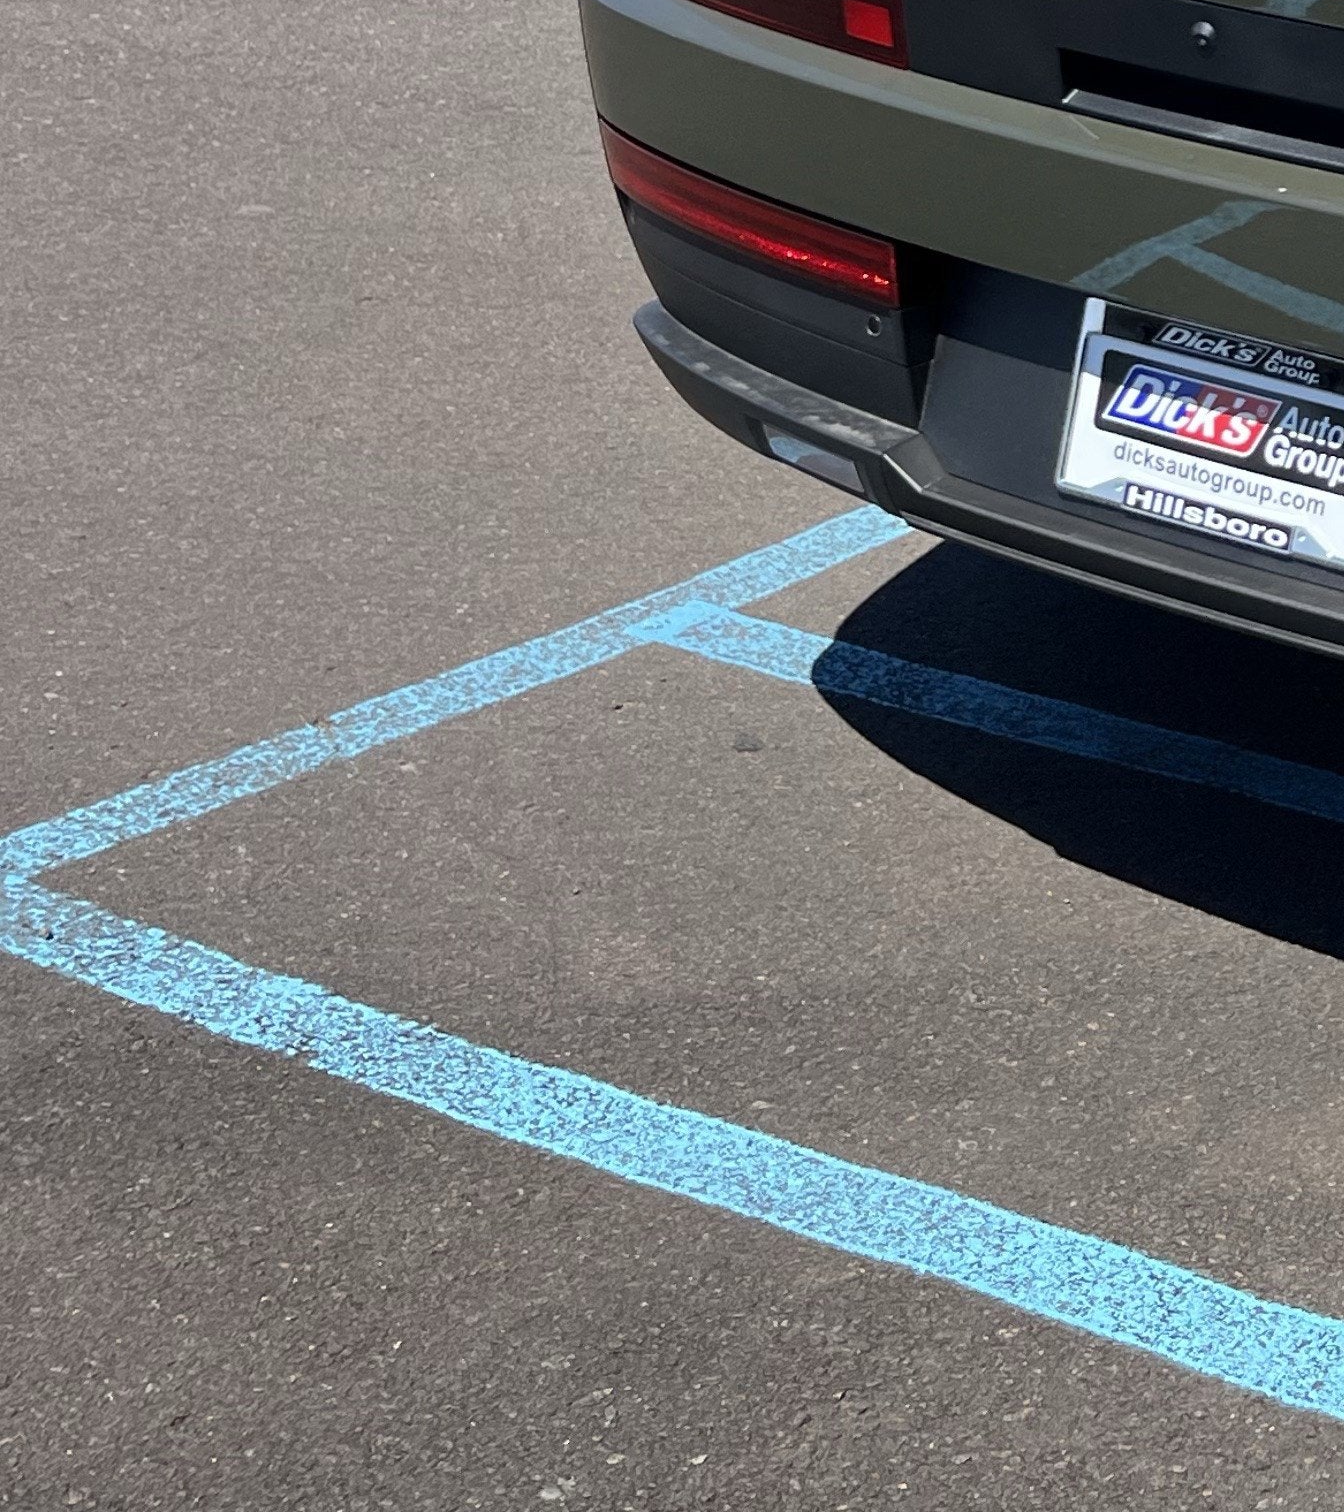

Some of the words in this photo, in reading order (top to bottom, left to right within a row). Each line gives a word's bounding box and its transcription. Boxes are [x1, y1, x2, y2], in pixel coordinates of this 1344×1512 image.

[1160, 326, 1257, 363] Dick's
[1271, 349, 1316, 371] Auto
[1114, 441, 1326, 516] dicksautogroup.com
[1125, 484, 1289, 546] Hillsboro
